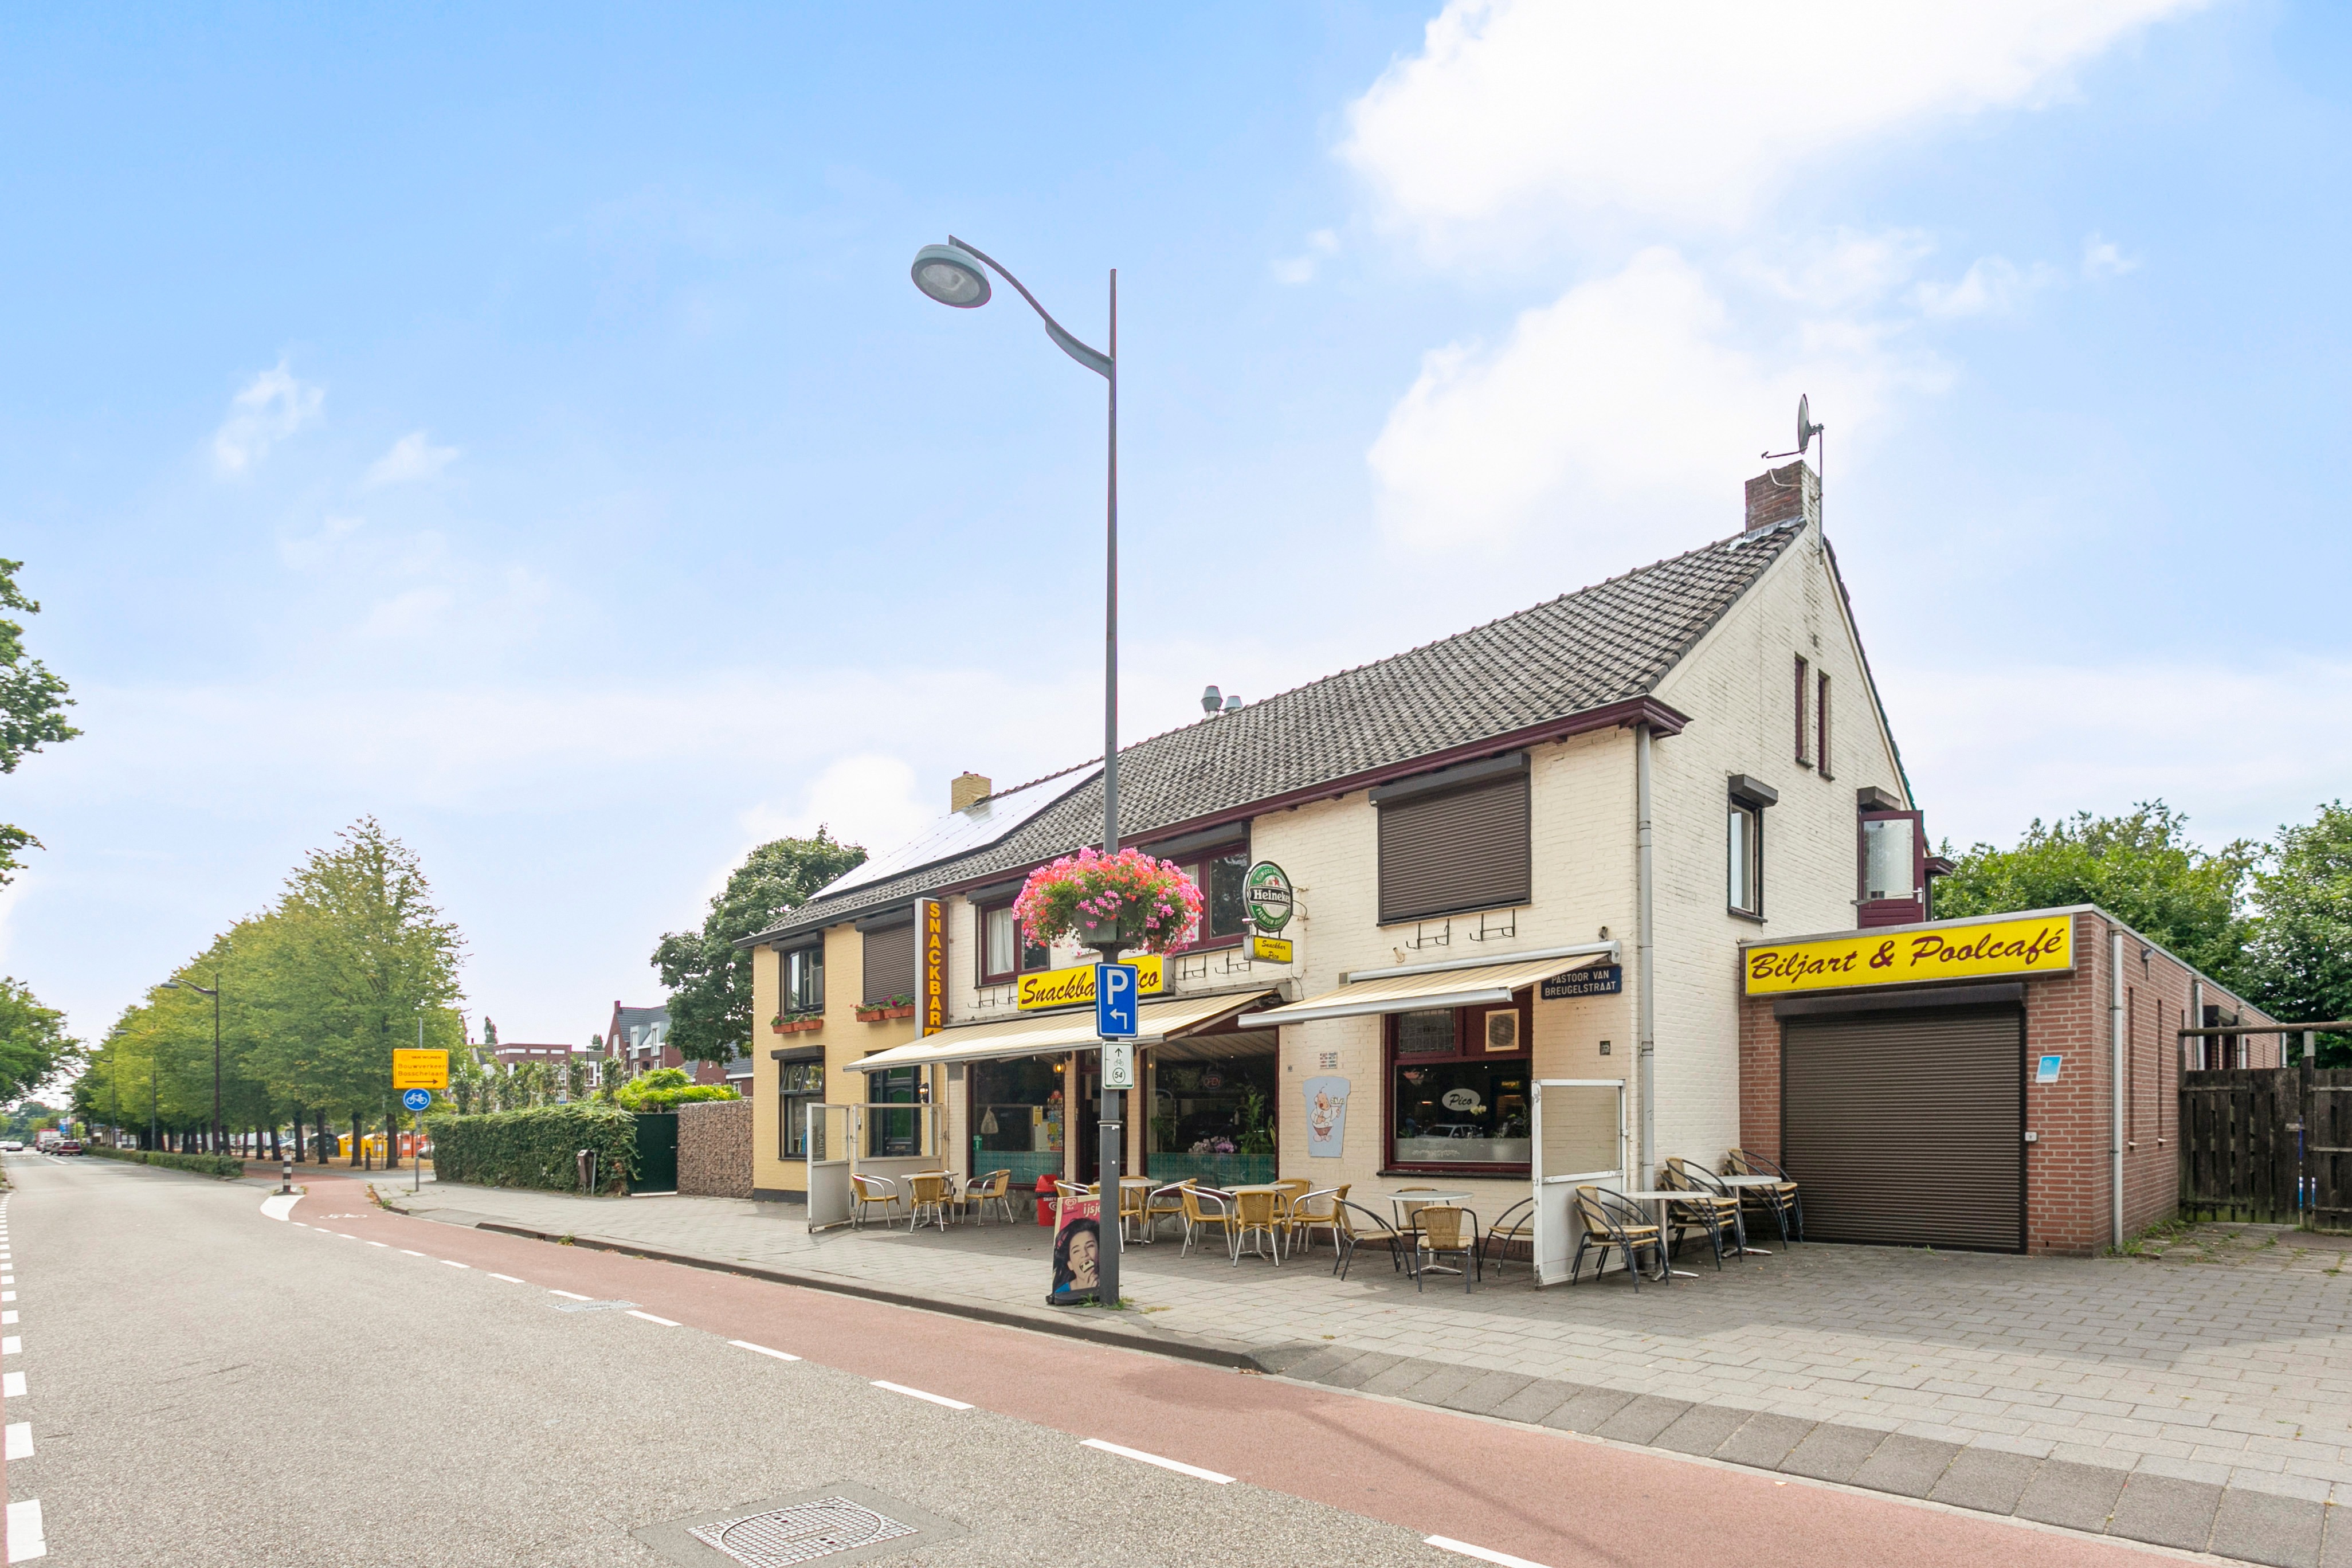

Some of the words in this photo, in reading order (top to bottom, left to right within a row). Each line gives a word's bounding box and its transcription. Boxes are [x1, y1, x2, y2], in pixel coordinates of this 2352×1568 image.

[1256, 908, 1274, 924] PREMIUM
[1261, 940, 1286, 950] Snackbar
[1268, 951, 1279, 959] Pico
[1750, 951, 1859, 983] Biljart
[1869, 940, 1895, 969] &
[1910, 927, 2065, 967] Poolcafé
[928, 902, 942, 1026] SNACKBAR
[1551, 972, 1589, 984] PASTOOR
[1593, 970, 1609, 980] VAN
[1021, 971, 1096, 1005] Snackba
[1137, 970, 1159, 989] co
[1107, 969, 1129, 1005] P
[1545, 981, 1616, 996] BREUGELSTRAAT
[1449, 1093, 1472, 1106] Pico
